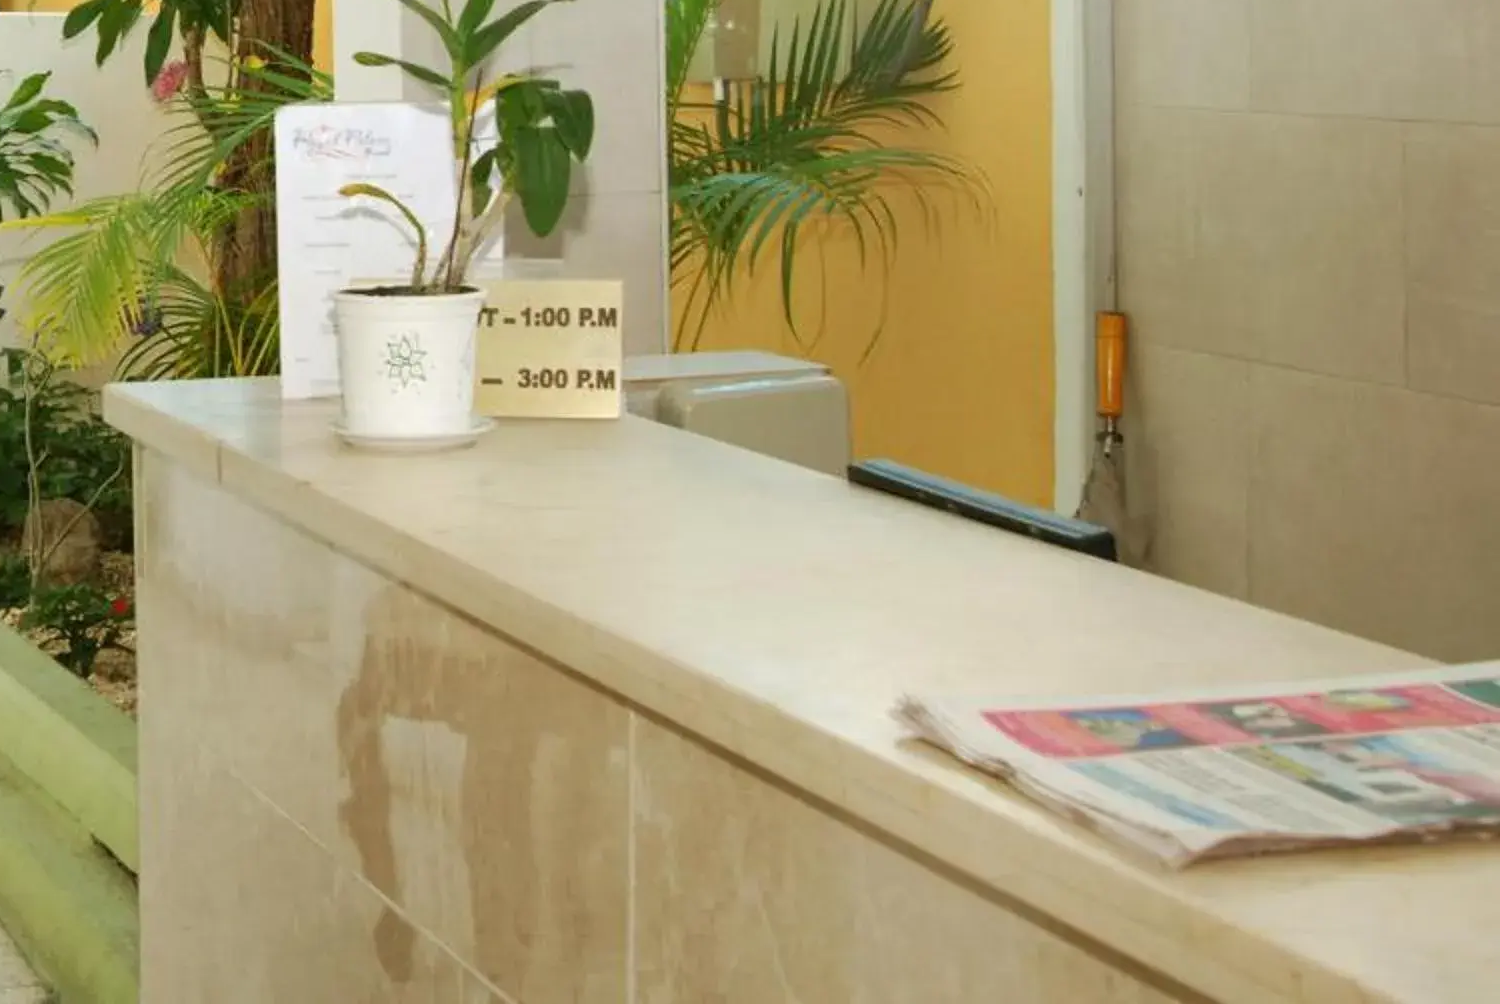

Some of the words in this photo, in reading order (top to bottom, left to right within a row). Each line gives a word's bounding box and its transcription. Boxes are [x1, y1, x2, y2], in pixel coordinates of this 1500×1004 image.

[477, 306, 499, 328] T
[520, 306, 571, 328] 1:00
[578, 306, 618, 328] P.M
[517, 368, 569, 390] 3:00
[576, 369, 616, 390] P.M
